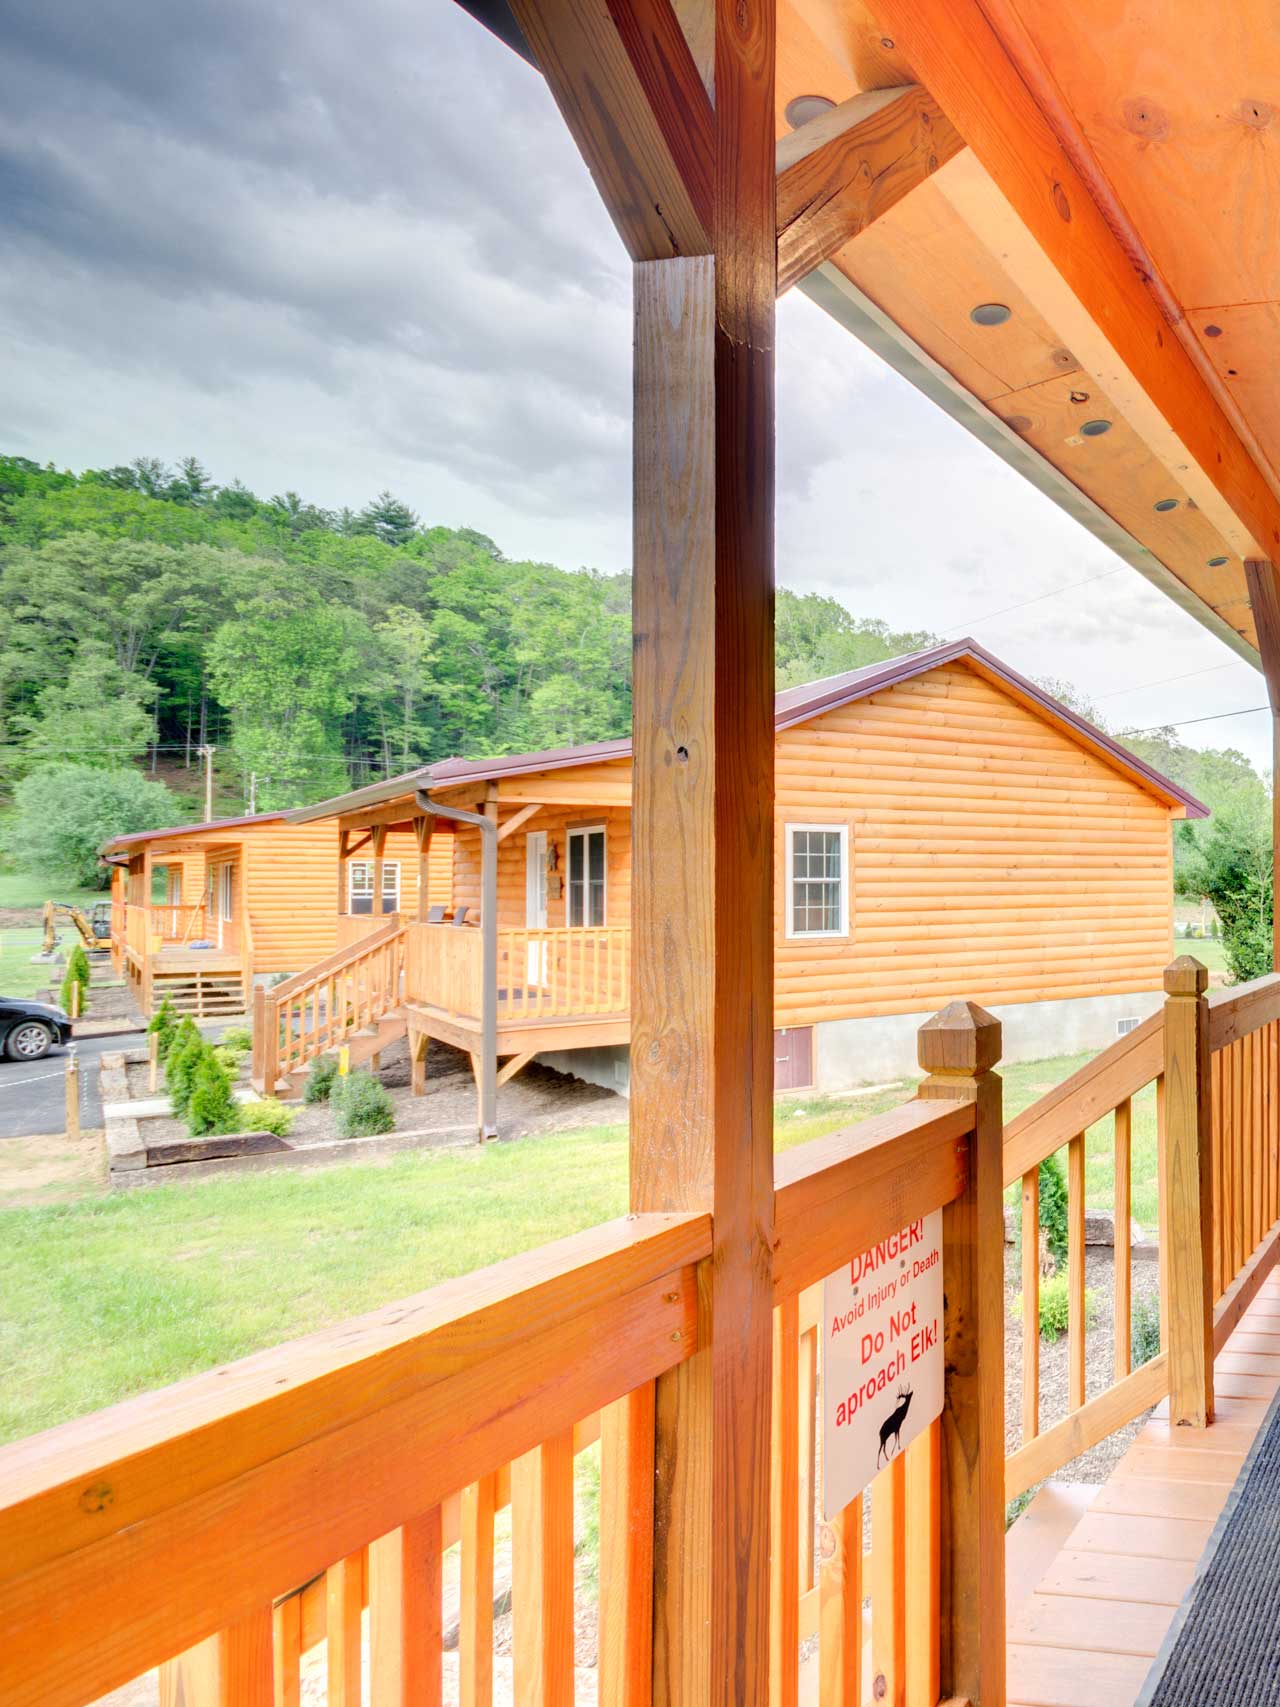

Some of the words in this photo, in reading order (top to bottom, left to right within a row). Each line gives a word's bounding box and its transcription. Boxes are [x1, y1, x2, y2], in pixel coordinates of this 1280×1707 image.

[850, 1217, 924, 1286] DANGER!
[831, 1293, 865, 1337] Avoid
[868, 1277, 897, 1313] Injury
[900, 1270, 911, 1288] or
[913, 1248, 940, 1281] Death
[835, 1348, 906, 1427] aproach
[911, 1318, 938, 1363] Elk!
[861, 1331, 884, 1366] Do
[889, 1301, 918, 1339] Not
